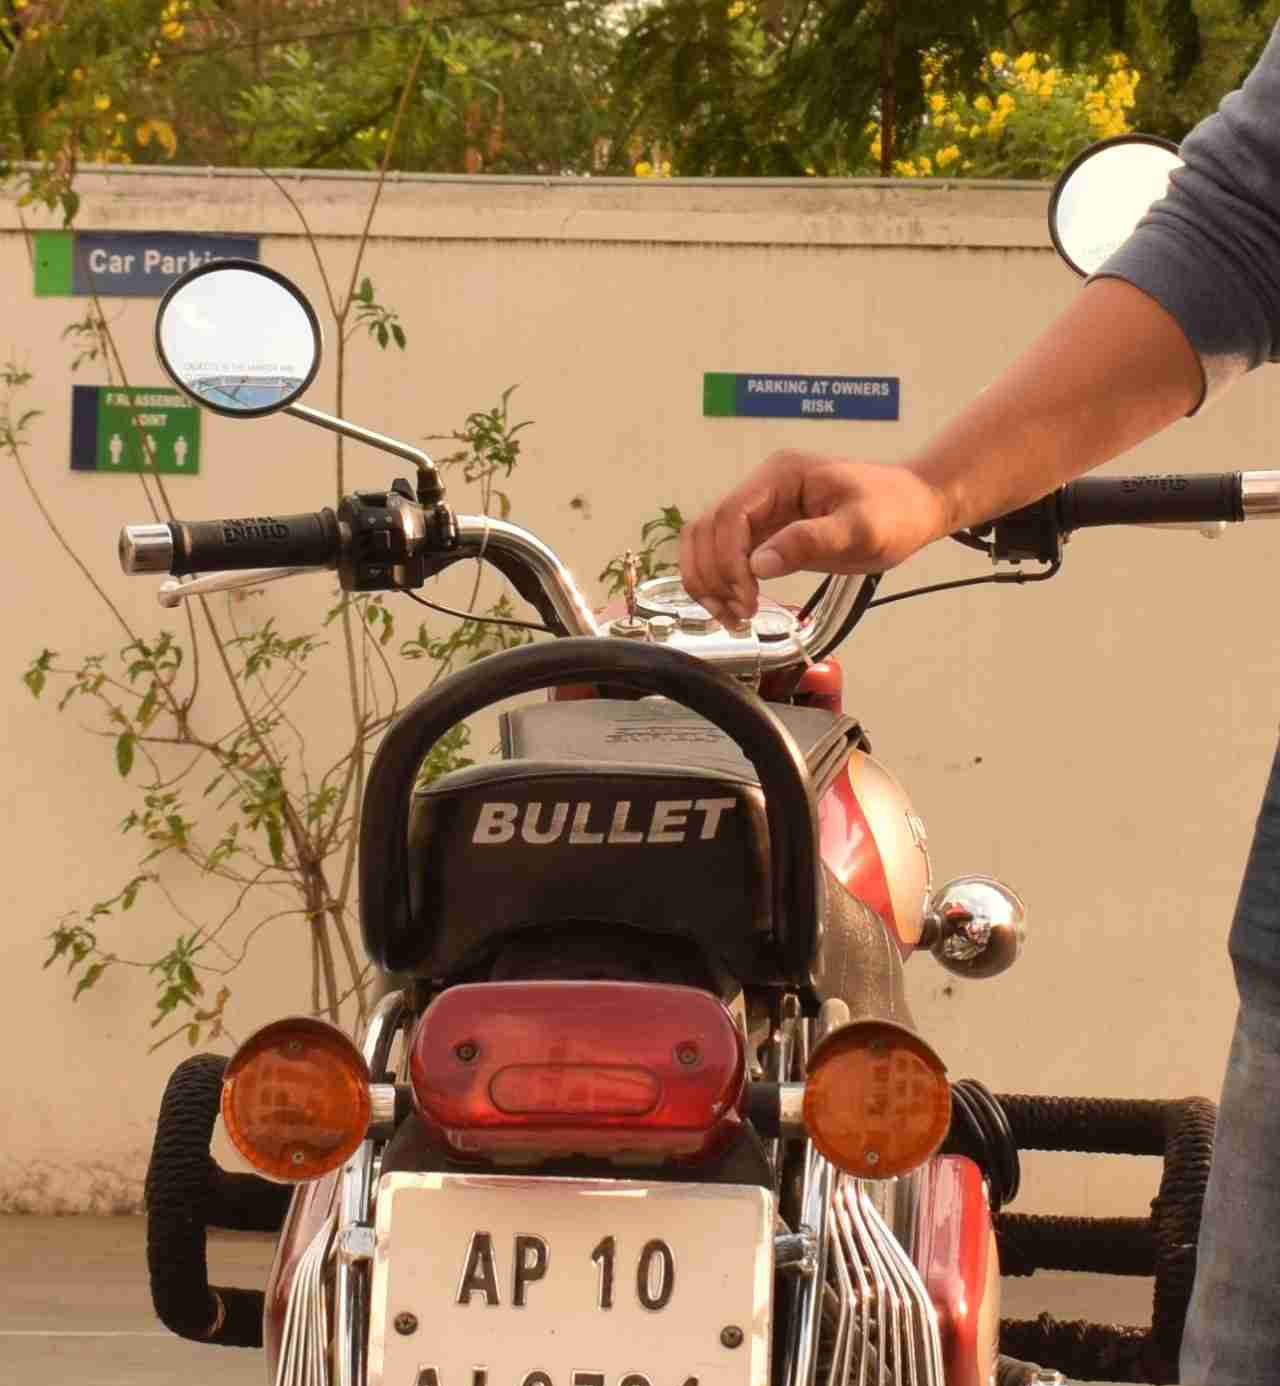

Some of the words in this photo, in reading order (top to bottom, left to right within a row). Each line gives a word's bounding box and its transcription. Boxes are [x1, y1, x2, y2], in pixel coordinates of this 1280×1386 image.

[89, 249, 135, 274] Car
[747, 379, 808, 394] PARKING
[811, 380, 829, 395] AT
[831, 381, 889, 396] OWNERS
[801, 399, 834, 413] RISK
[472, 798, 737, 844] BULLET
[457, 1232, 550, 1307] AP
[591, 1235, 675, 1312] 10
